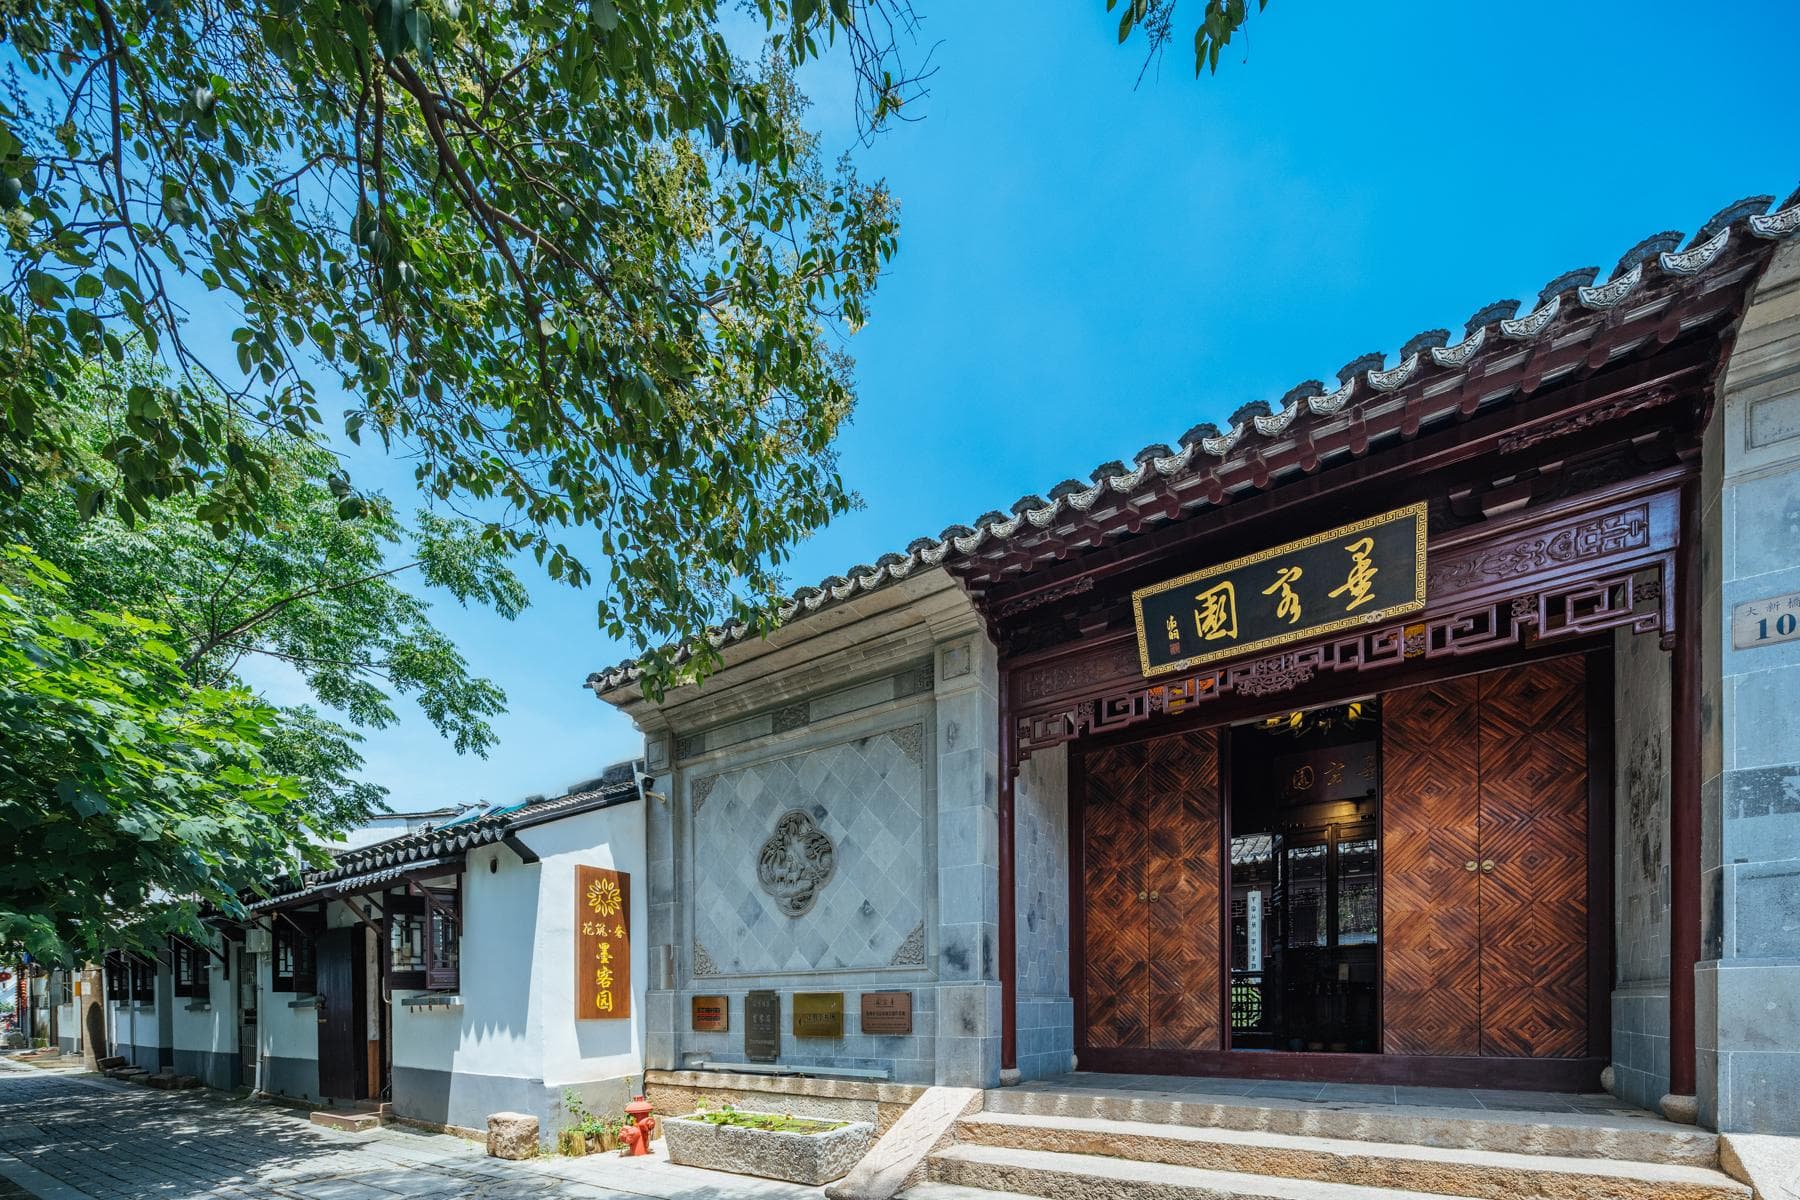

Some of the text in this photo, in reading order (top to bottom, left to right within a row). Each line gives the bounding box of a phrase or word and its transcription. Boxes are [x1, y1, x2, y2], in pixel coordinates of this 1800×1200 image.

[1754, 613, 1797, 641] 10
[595, 942, 614, 1013] 墨客园
